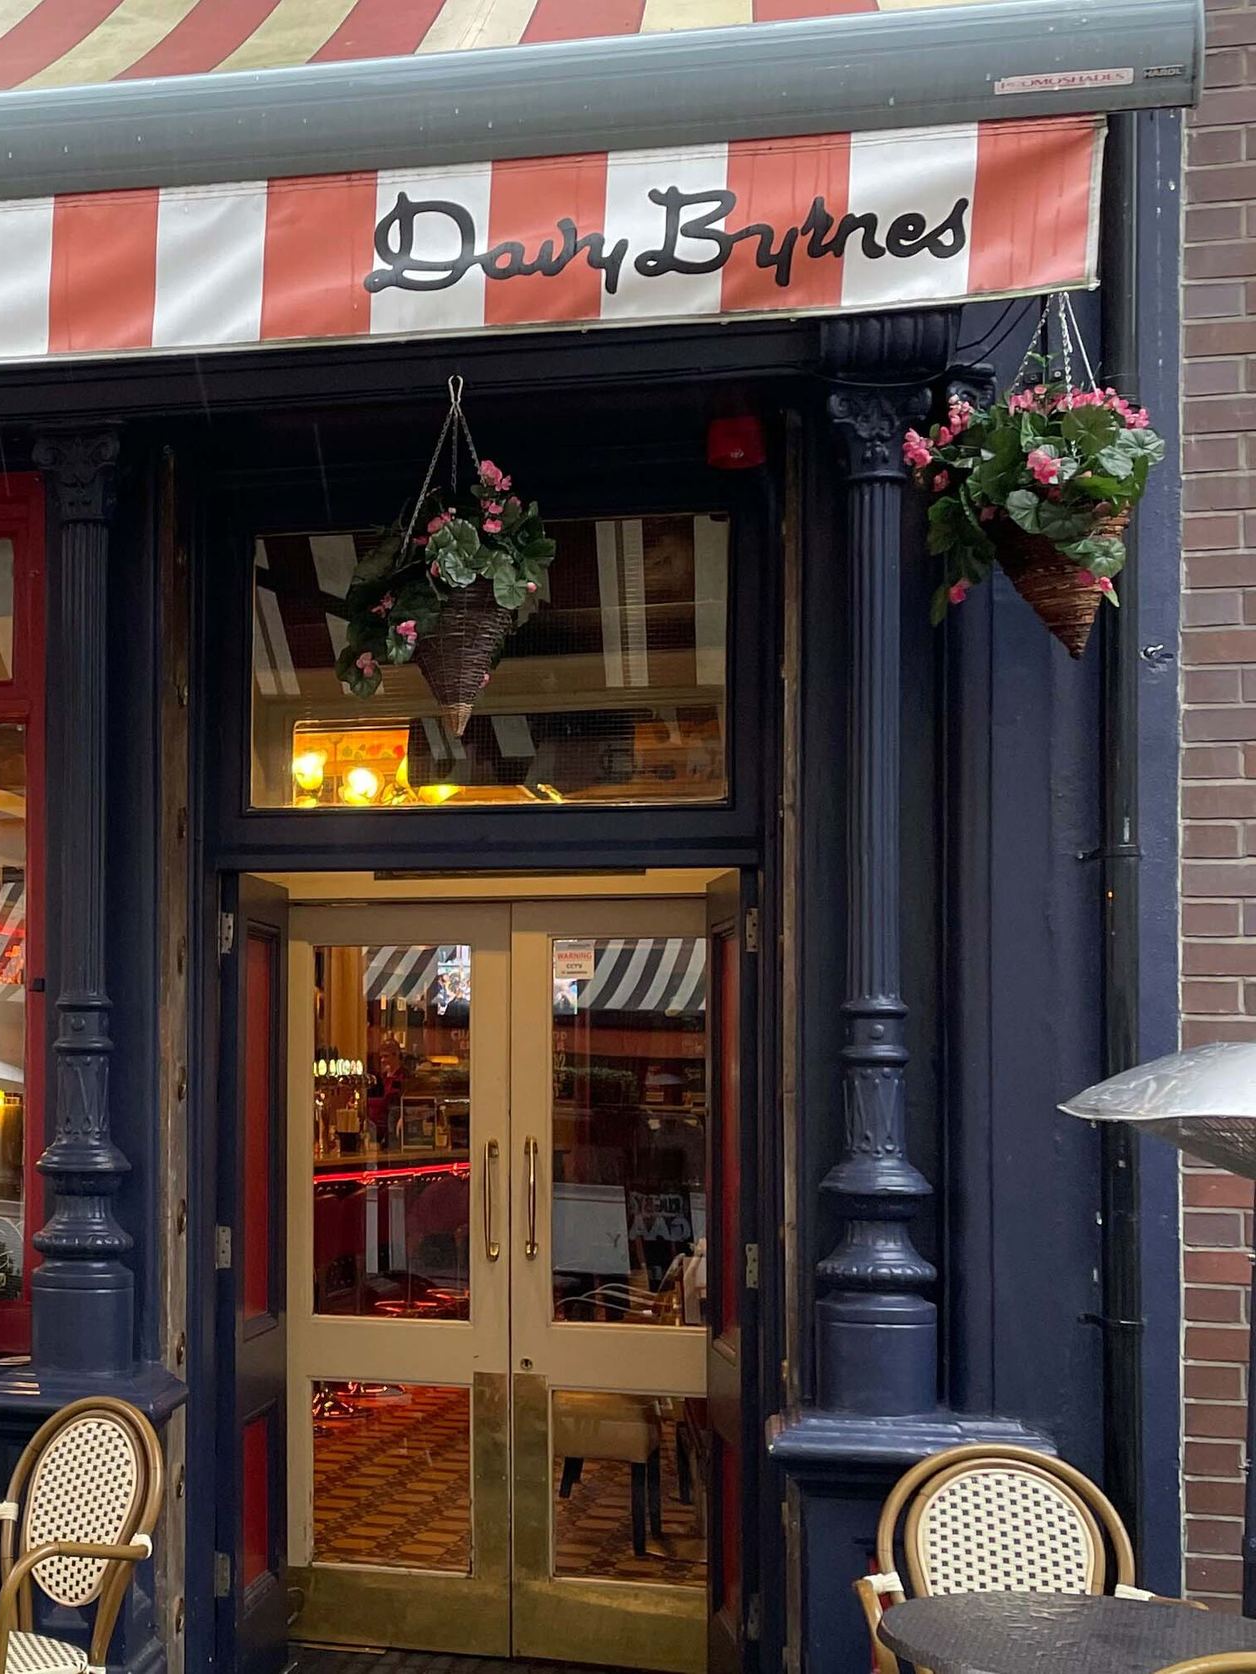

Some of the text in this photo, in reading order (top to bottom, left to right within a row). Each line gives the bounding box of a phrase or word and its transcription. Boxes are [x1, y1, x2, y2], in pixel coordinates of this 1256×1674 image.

[364, 185, 969, 294] Davy Byrnes
[557, 951, 592, 960] WARNING
